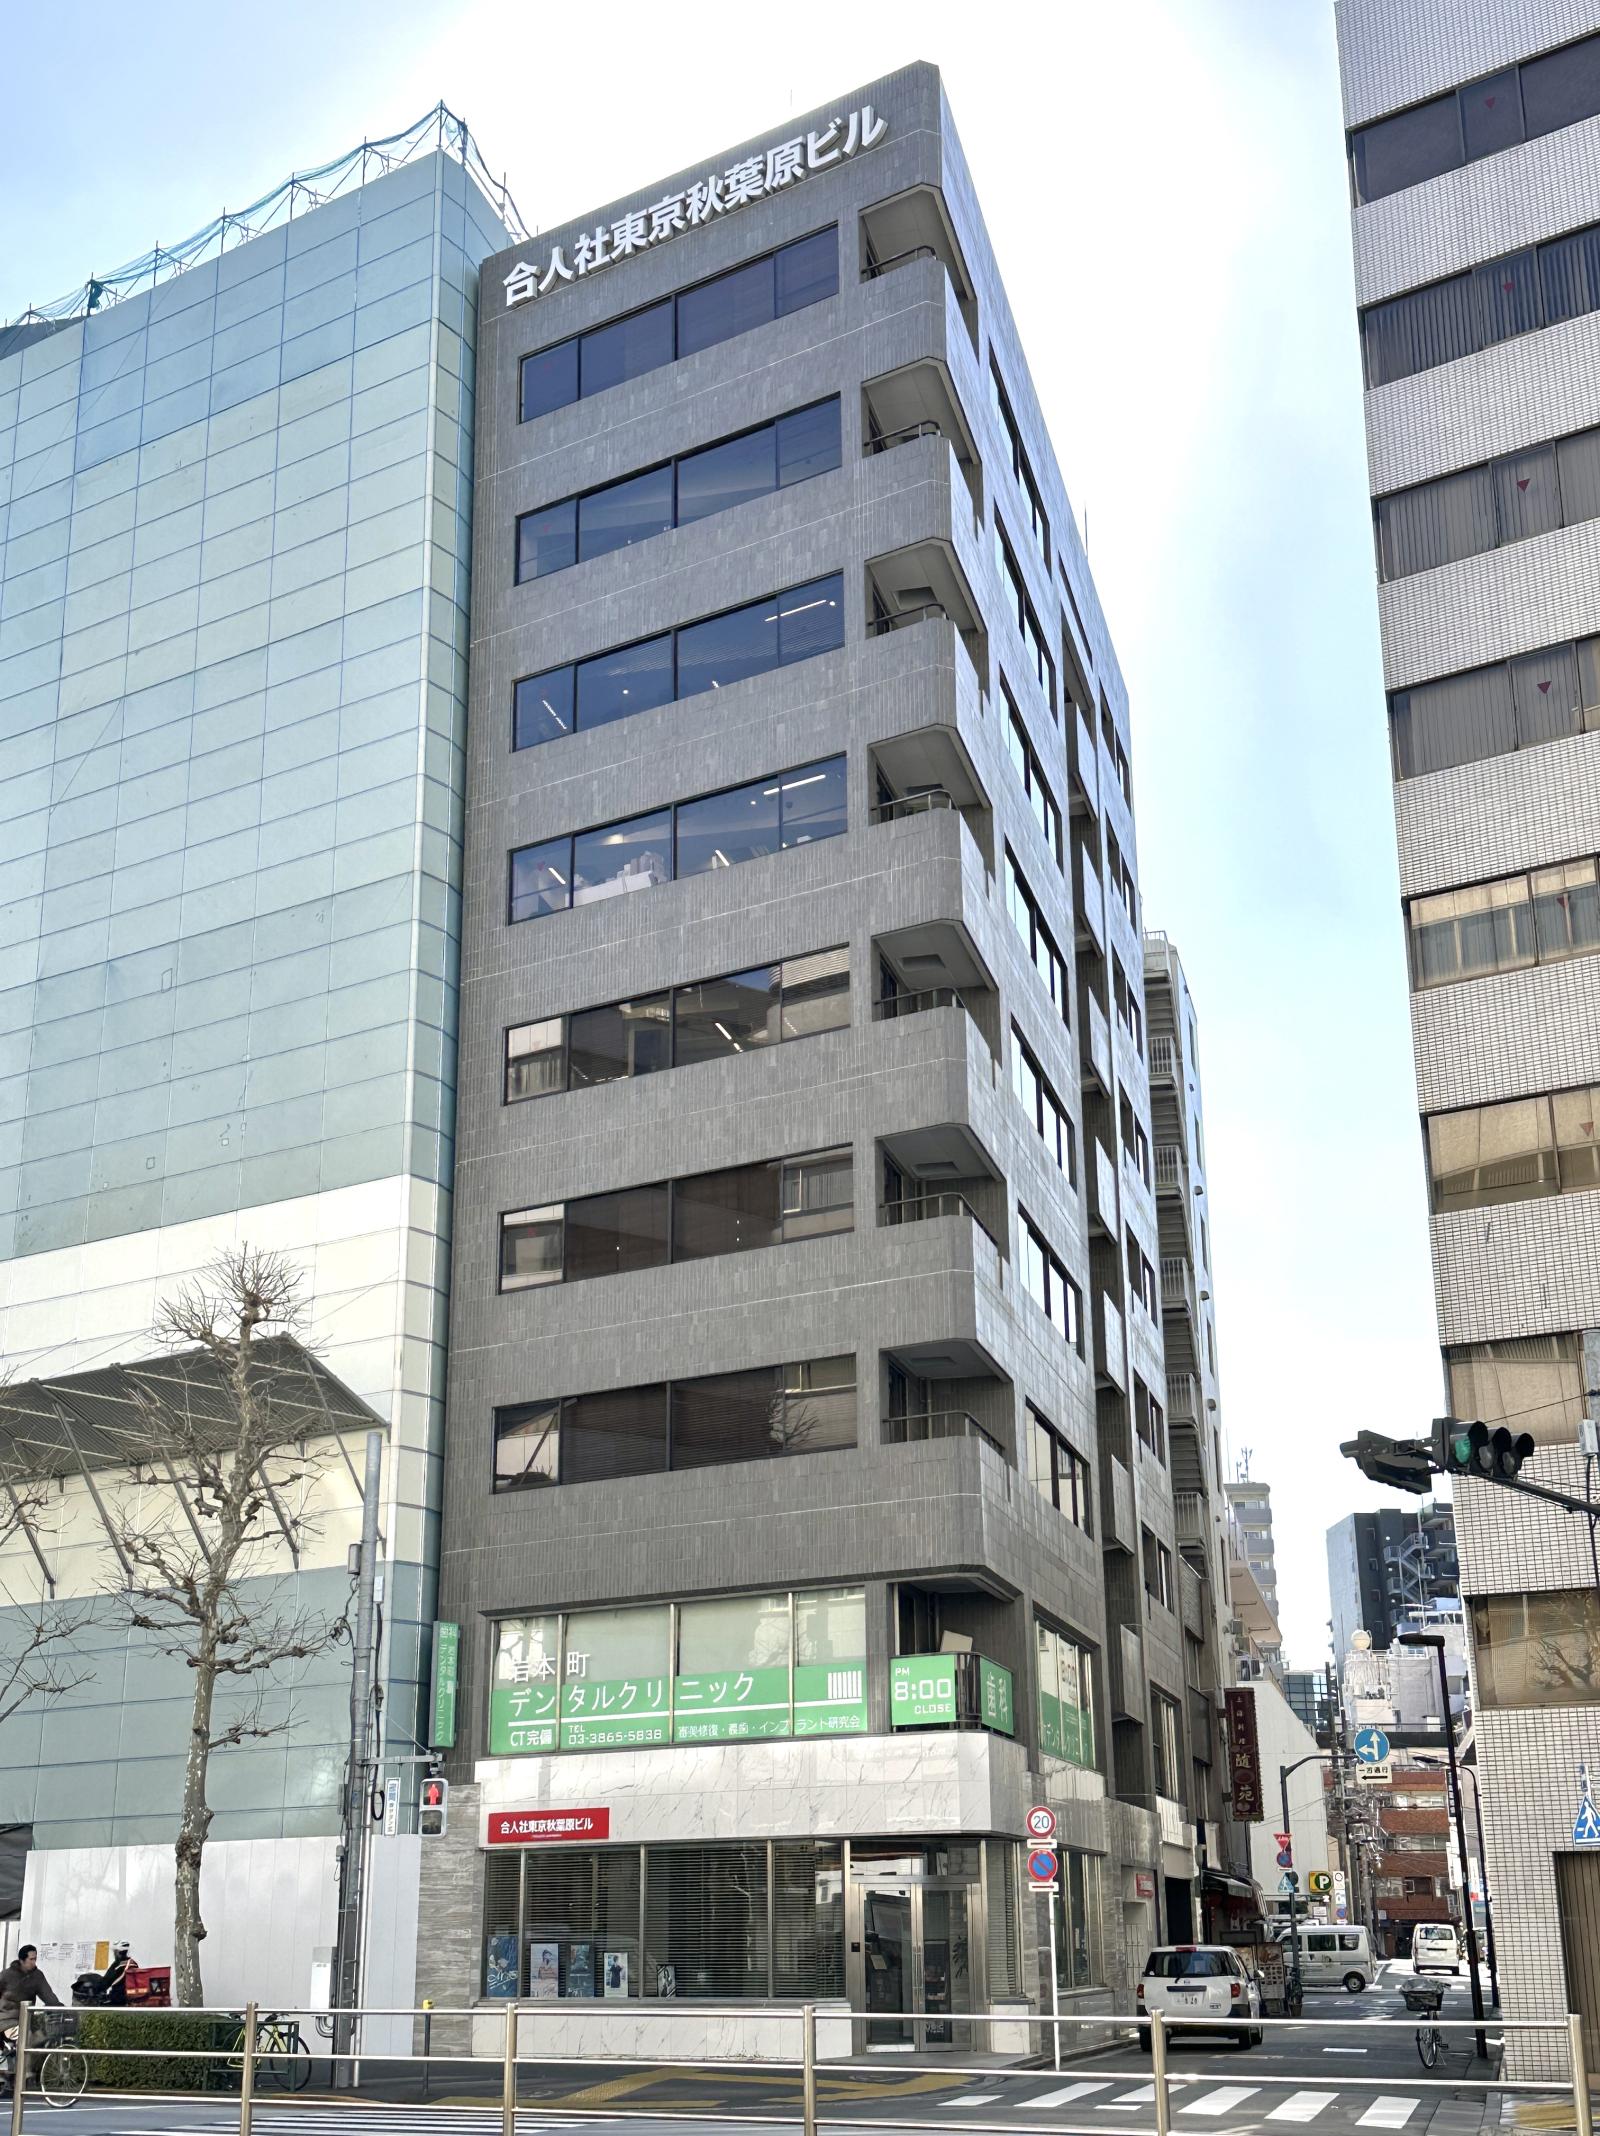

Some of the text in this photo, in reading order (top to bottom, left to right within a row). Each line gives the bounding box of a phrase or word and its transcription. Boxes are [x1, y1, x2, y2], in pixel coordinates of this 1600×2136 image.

[502, 104, 889, 307] 合人社東京秋葉原ビル
[512, 1651, 591, 1684] 岩本町
[895, 1667, 910, 1676] PM
[509, 1672, 754, 1717] デンタルクリニック
[895, 1678, 952, 1701] 8:00
[914, 1703, 952, 1715] CLOSE
[510, 1728, 553, 1747] CT完備
[568, 1724, 586, 1733] TEL
[500, 1817, 594, 1835] 合人社東京秋葉原ビル
[1033, 1815, 1050, 1829] 20
[1319, 1875, 1330, 1889] P
